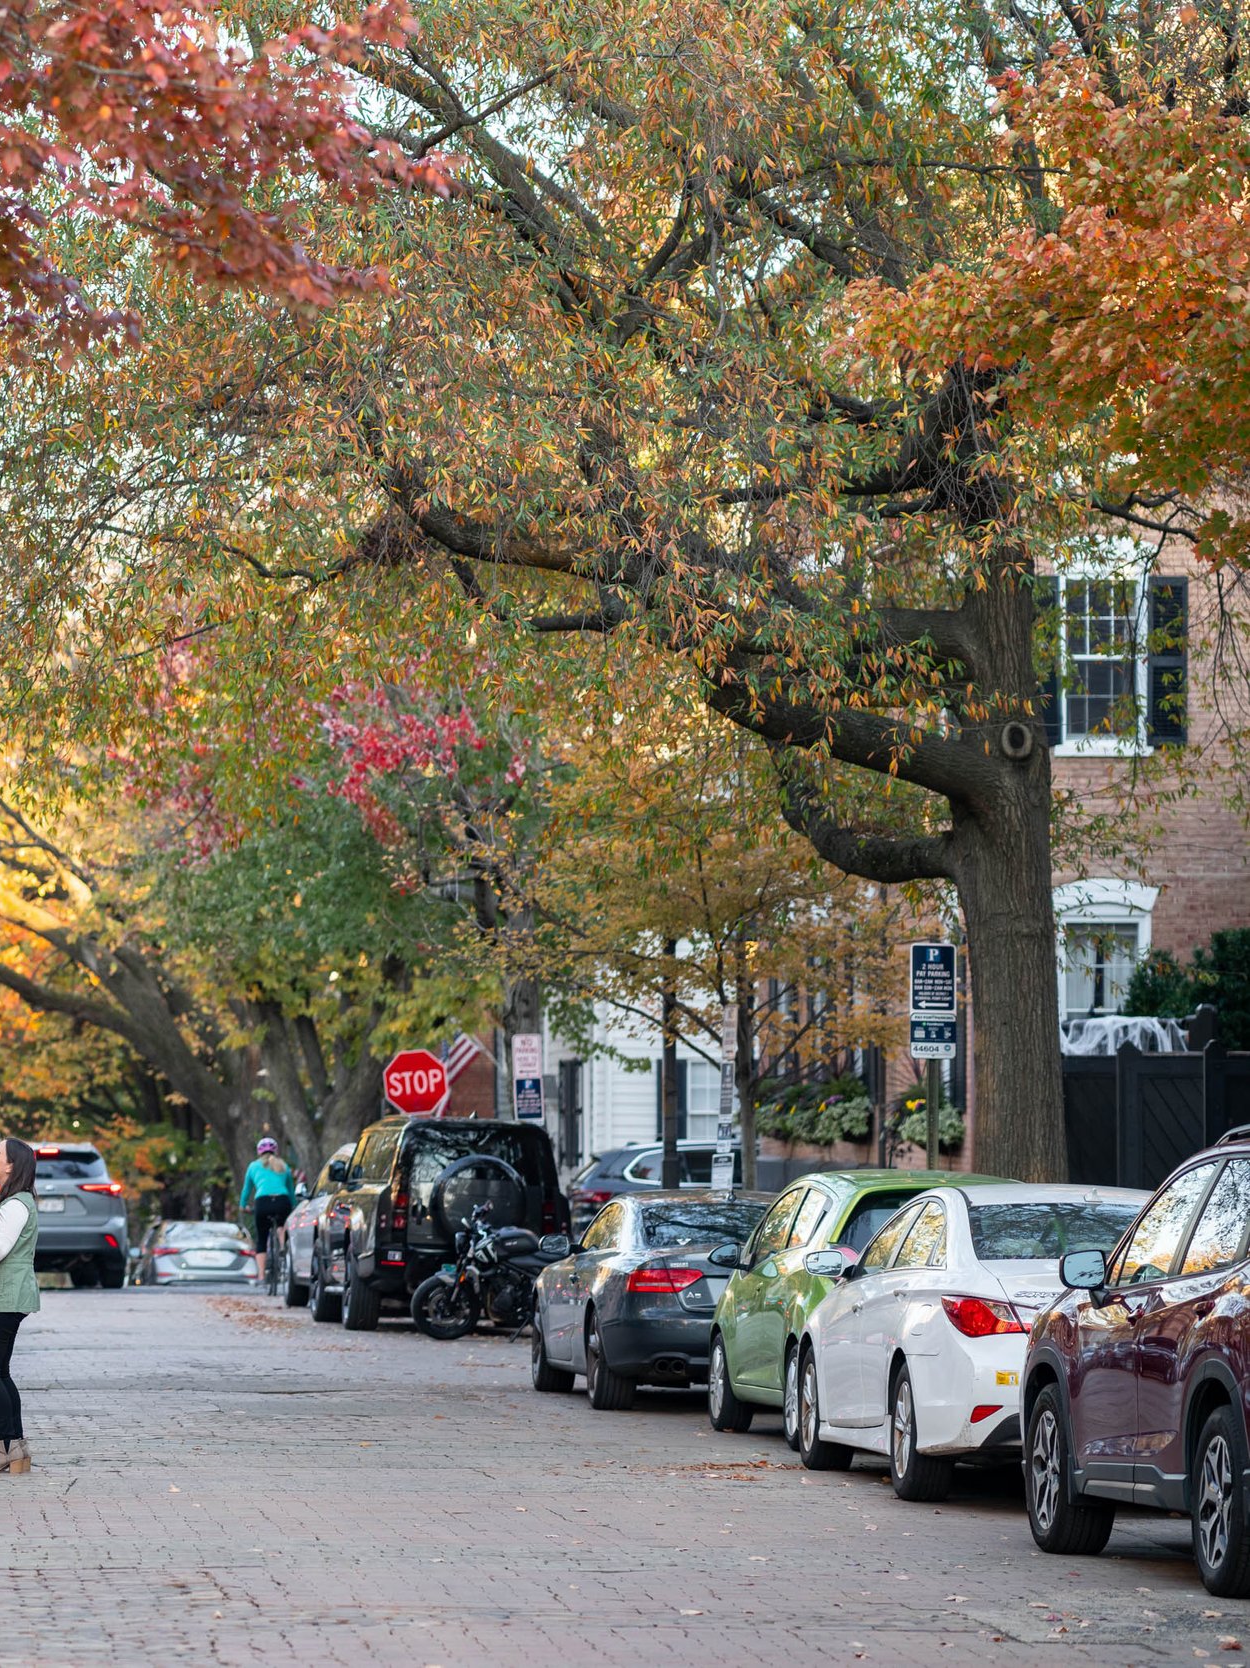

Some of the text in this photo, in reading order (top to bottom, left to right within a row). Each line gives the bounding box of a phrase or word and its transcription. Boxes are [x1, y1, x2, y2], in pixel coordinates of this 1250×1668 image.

[928, 948, 939, 962] P
[927, 970, 951, 978] PARKING
[389, 1069, 442, 1098] STOP
[686, 1291, 702, 1299] A5
[1014, 1290, 1061, 1298] SONAT
